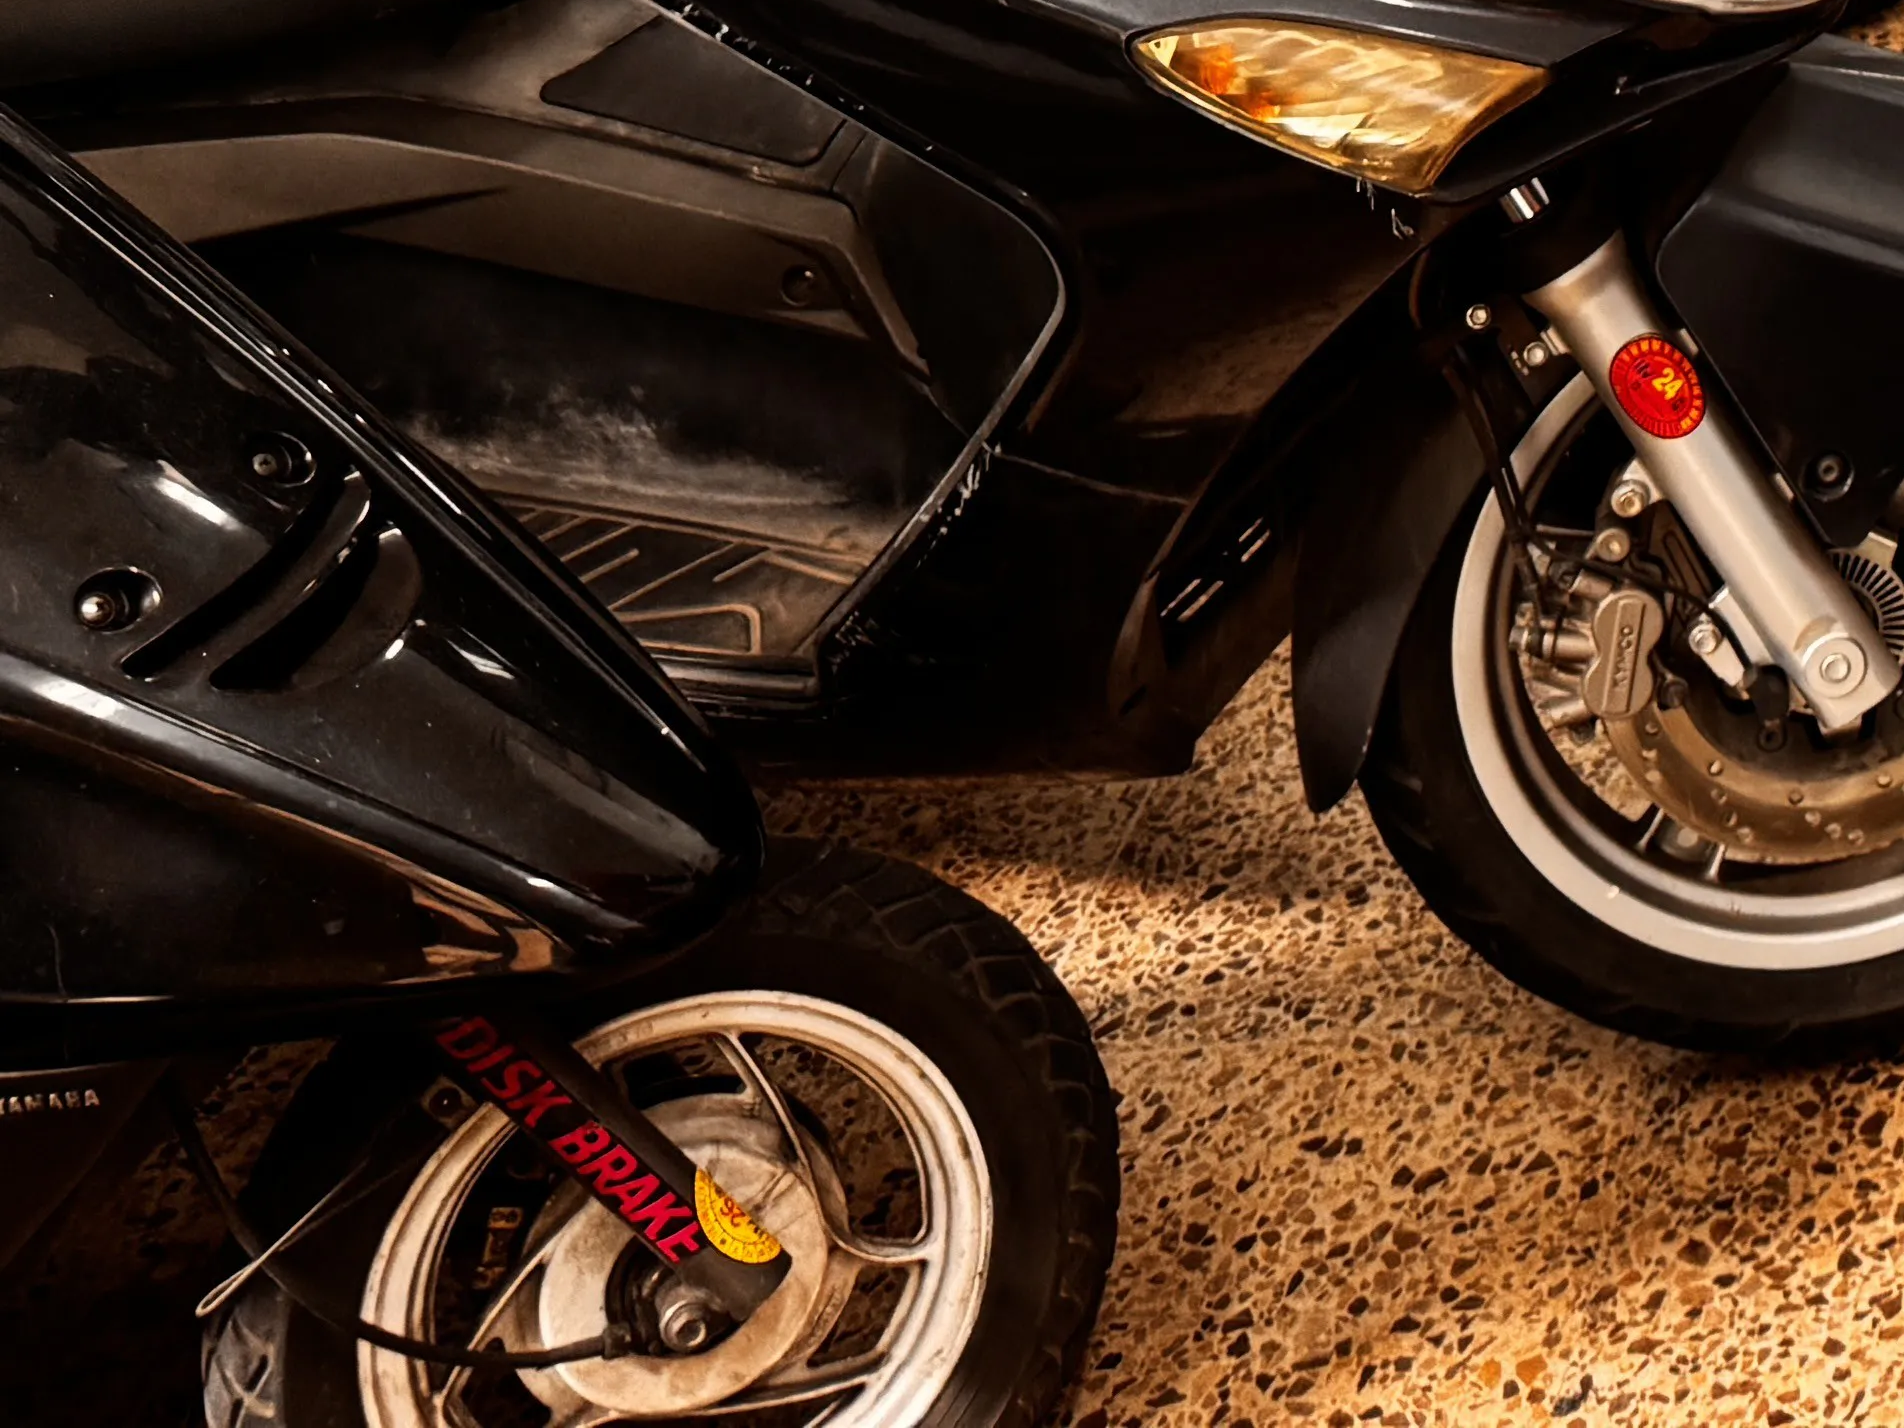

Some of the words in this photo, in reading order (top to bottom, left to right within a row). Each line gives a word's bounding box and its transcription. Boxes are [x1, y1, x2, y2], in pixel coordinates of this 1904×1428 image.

[1652, 367, 1684, 400] 24
[436, 1016, 572, 1128] DISK
[549, 1119, 700, 1264] BRAKE
